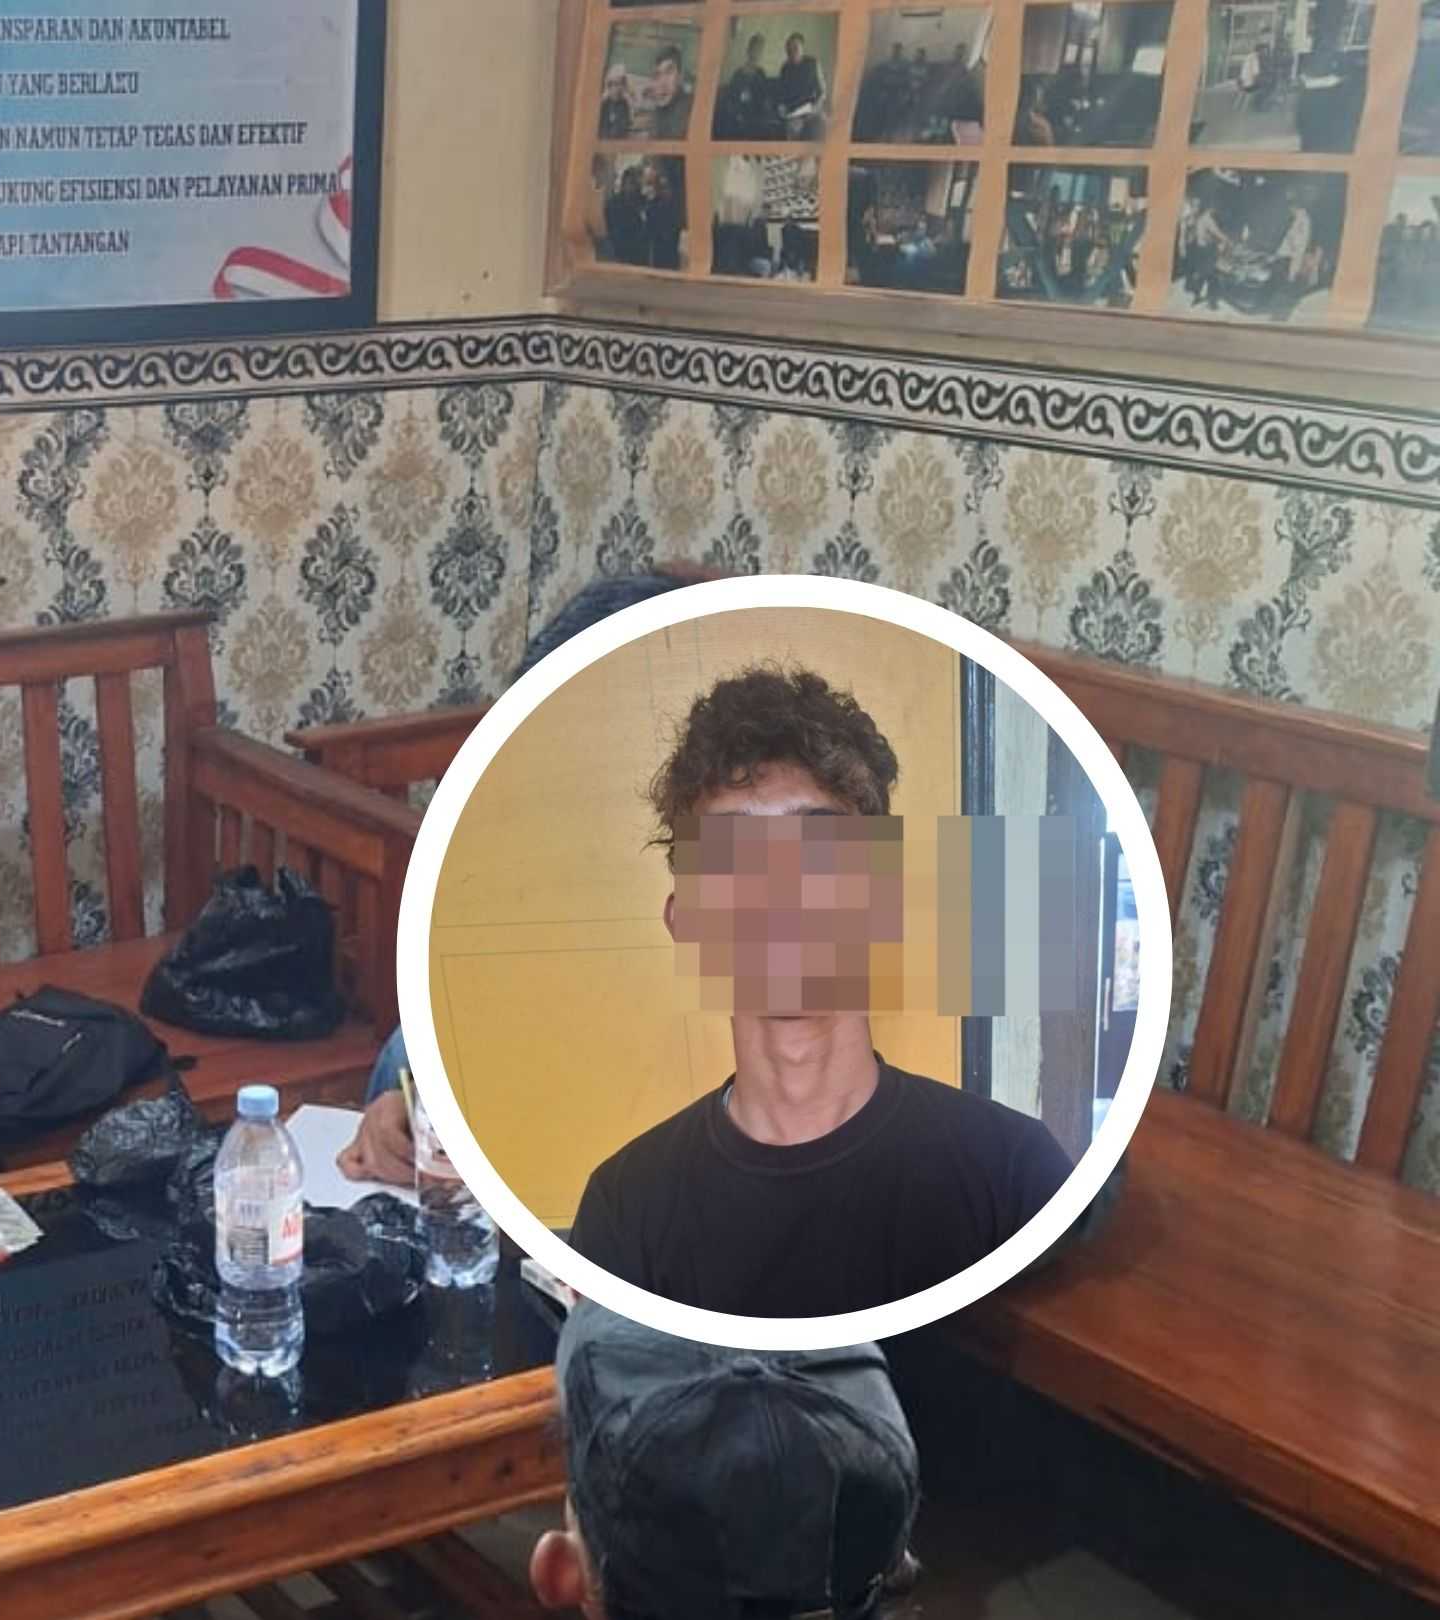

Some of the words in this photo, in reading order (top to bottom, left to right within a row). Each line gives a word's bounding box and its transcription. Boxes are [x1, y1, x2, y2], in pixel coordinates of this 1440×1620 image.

[88, 18, 123, 41] DAN
[128, 18, 231, 41] AKUNTABEL
[9, 73, 56, 97] YANG
[59, 72, 140, 95] BERLAKU
[15, 126, 80, 150] NAMUN
[84, 125, 138, 149] TETAP
[143, 124, 196, 147] TEGAS
[199, 124, 234, 147] DAN
[238, 122, 308, 145] EFEKTIF
[60, 178, 141, 202] EFISIENSI
[146, 177, 179, 200] DAN
[184, 174, 282, 198] PELAYANAN
[286, 172, 339, 195] PRIMA
[29, 230, 129, 254] TANTANGAN
